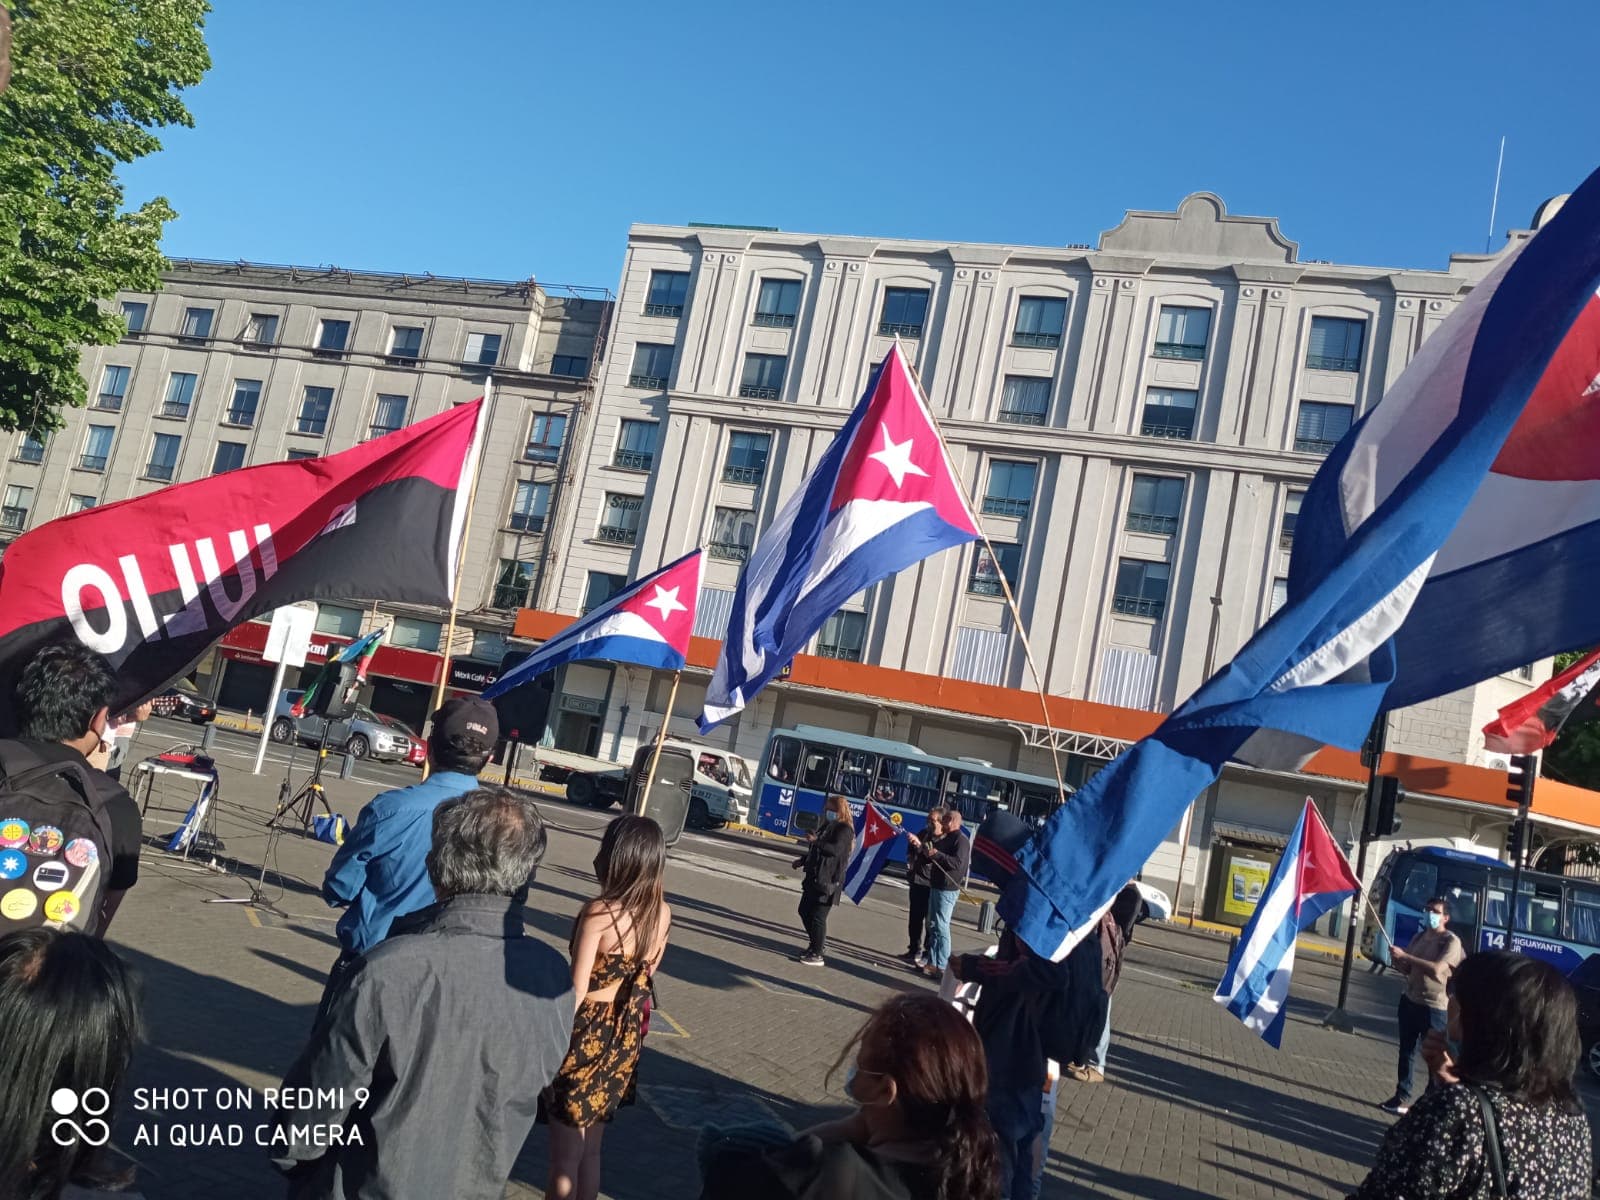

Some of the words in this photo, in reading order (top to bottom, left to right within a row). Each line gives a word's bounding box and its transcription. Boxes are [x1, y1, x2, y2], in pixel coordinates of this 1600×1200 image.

[454, 670, 470, 680] Work
[1486, 932, 1505, 950] 14
[1512, 937, 1563, 954] HIGUAYANTE
